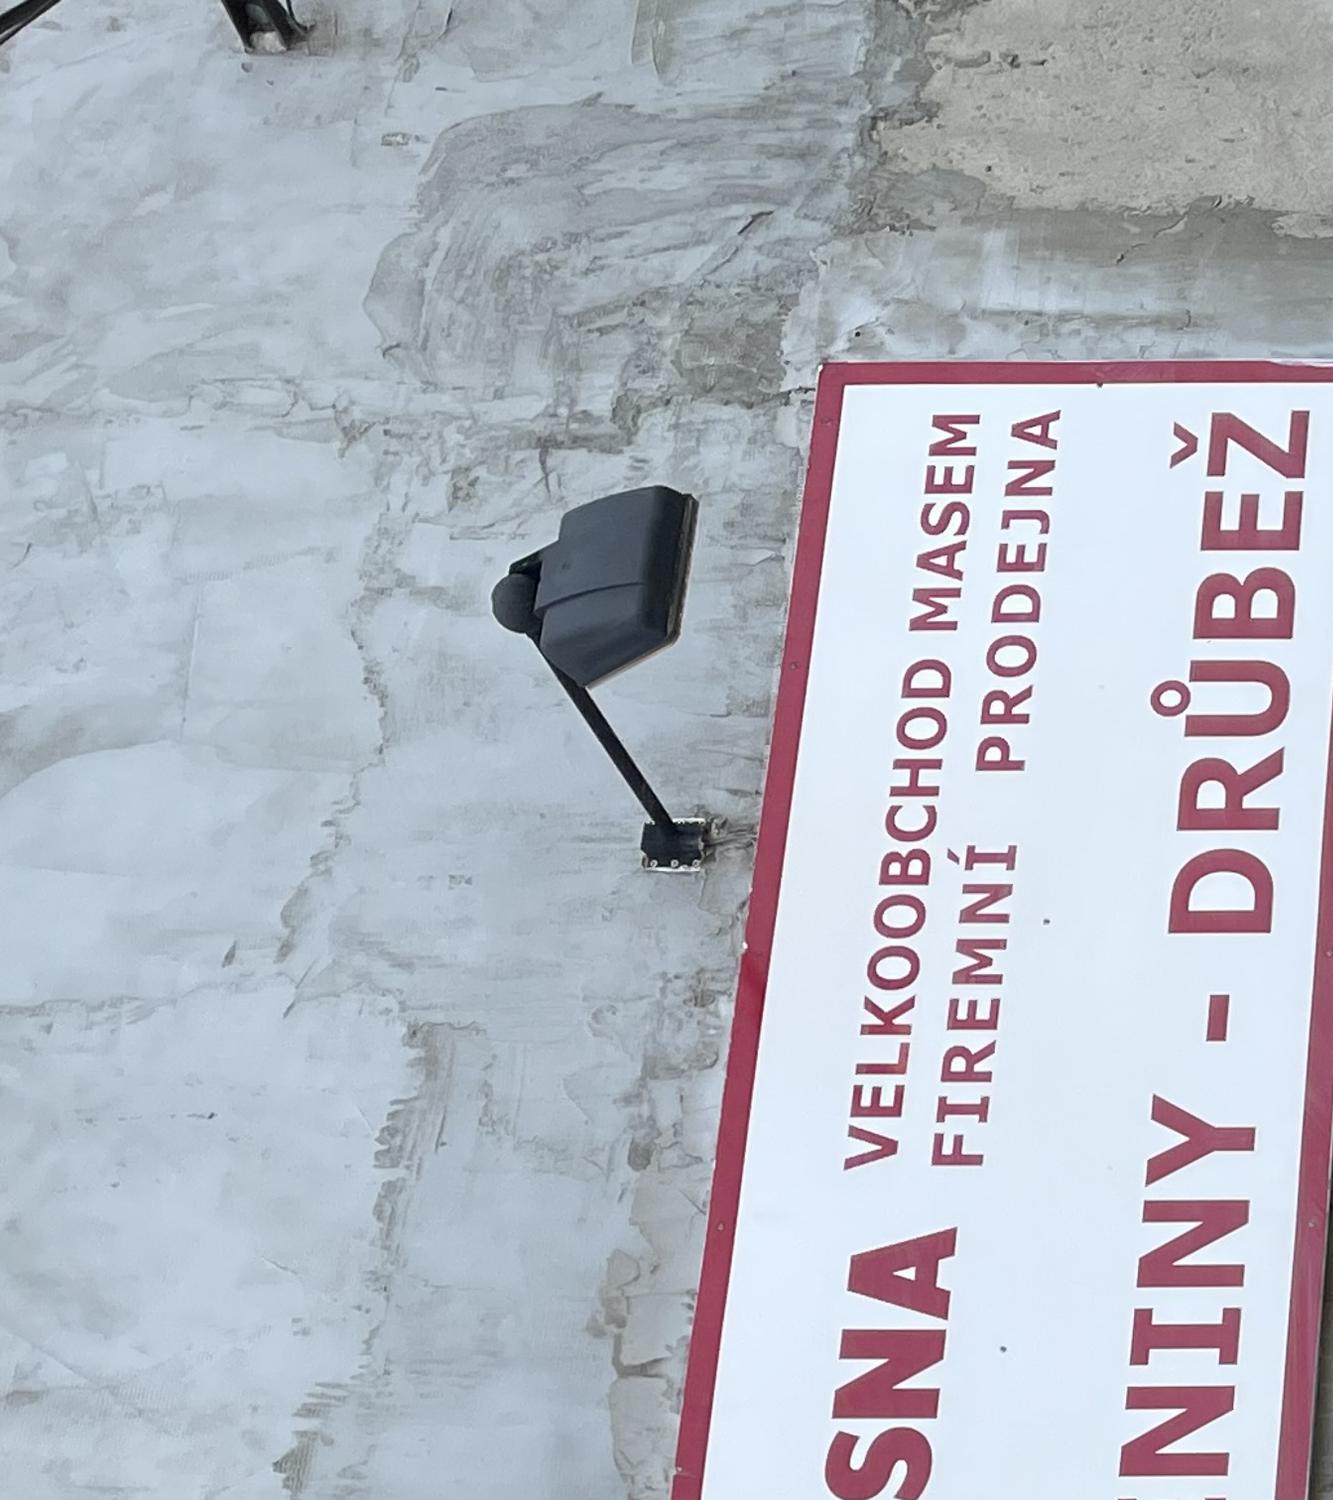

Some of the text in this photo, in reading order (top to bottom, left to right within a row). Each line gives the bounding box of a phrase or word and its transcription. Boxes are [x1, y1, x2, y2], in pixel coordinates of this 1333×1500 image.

[846, 416, 978, 1167] VELKOOBCHOD MASEM
[933, 414, 1057, 1164] FIREMNÍ PRODEJNA
[1153, 412, 1306, 933] DRŮBEŽ
[1208, 997, 1227, 1040] -
